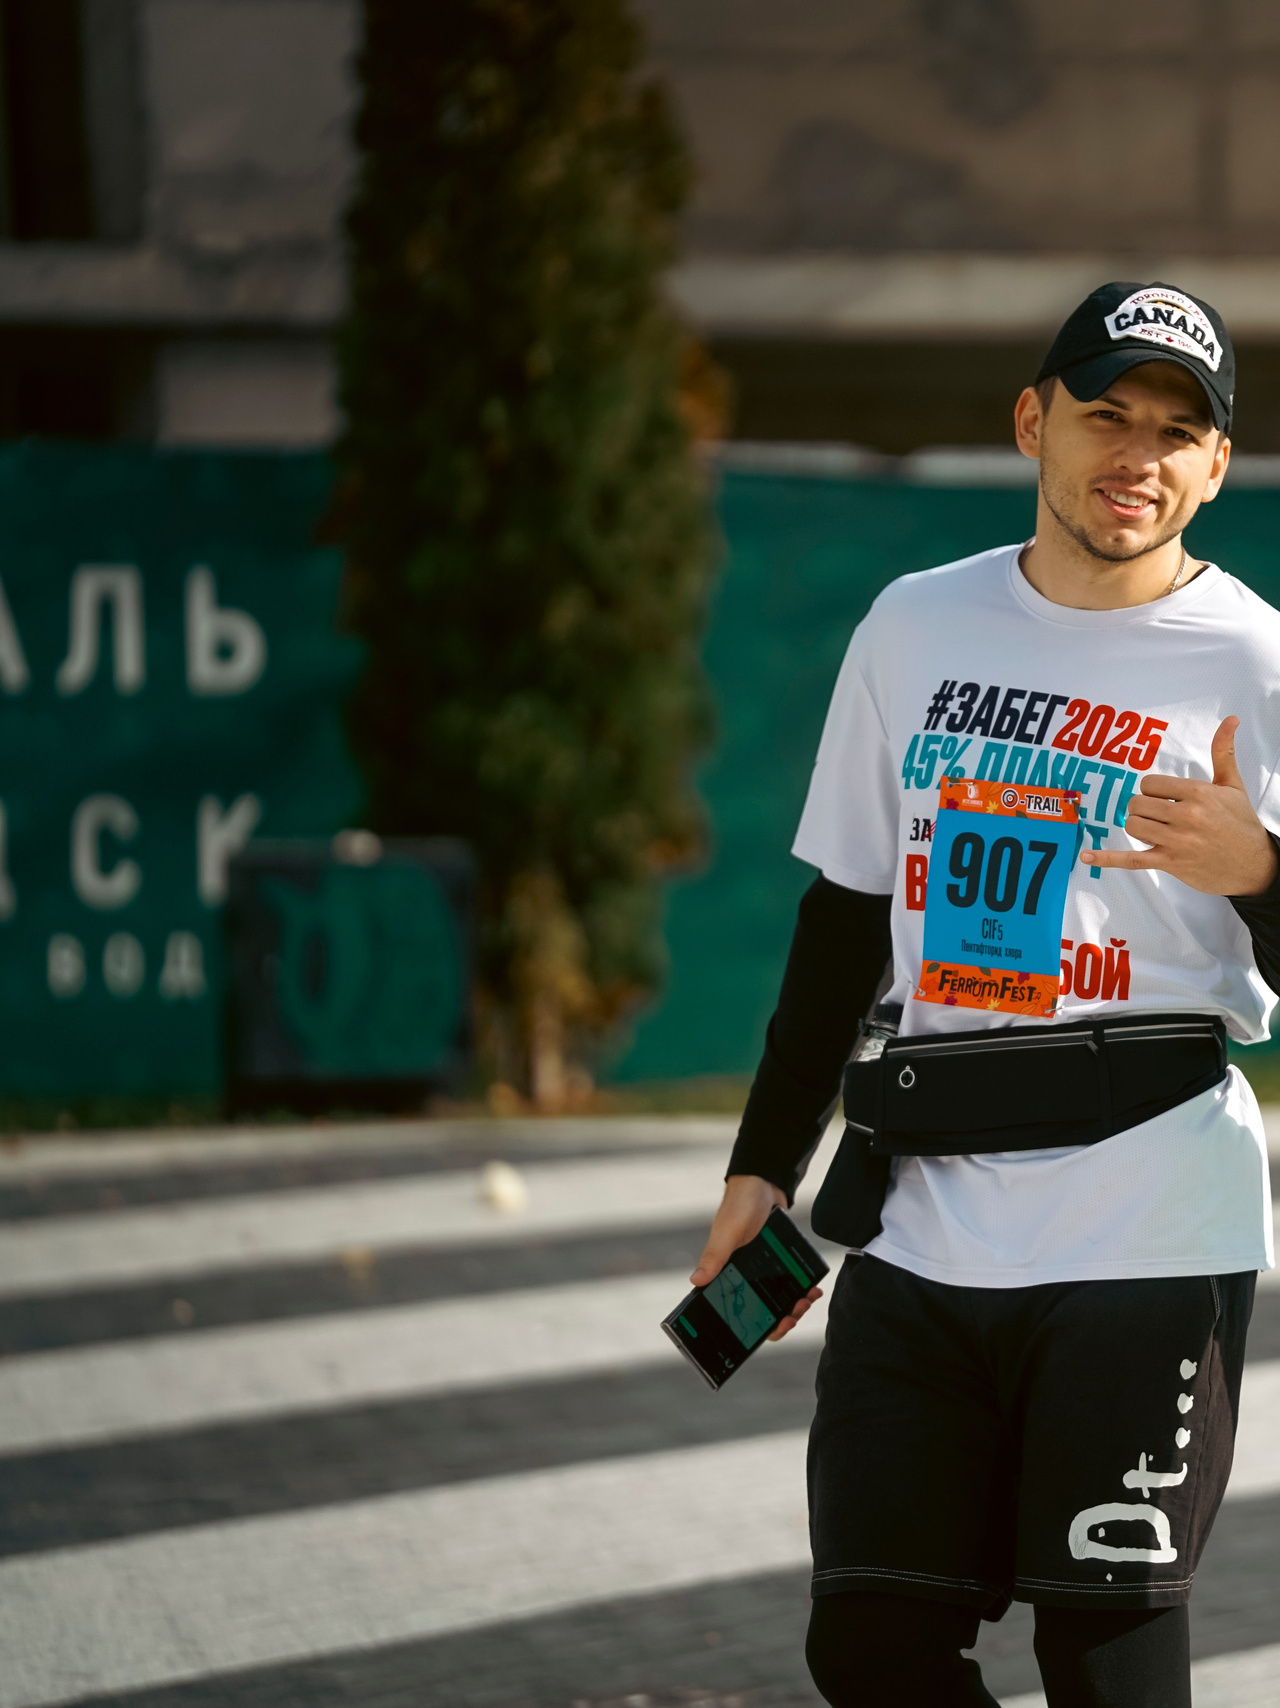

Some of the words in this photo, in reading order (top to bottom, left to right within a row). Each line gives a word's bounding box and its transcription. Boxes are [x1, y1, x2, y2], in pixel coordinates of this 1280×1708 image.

[1130, 292, 1185, 305] TORONTO
[1114, 307, 1215, 362] CANADA
[1138, 328, 1163, 339] EST
[902, 734, 972, 790] 45%
[946, 832, 1058, 915] 907
